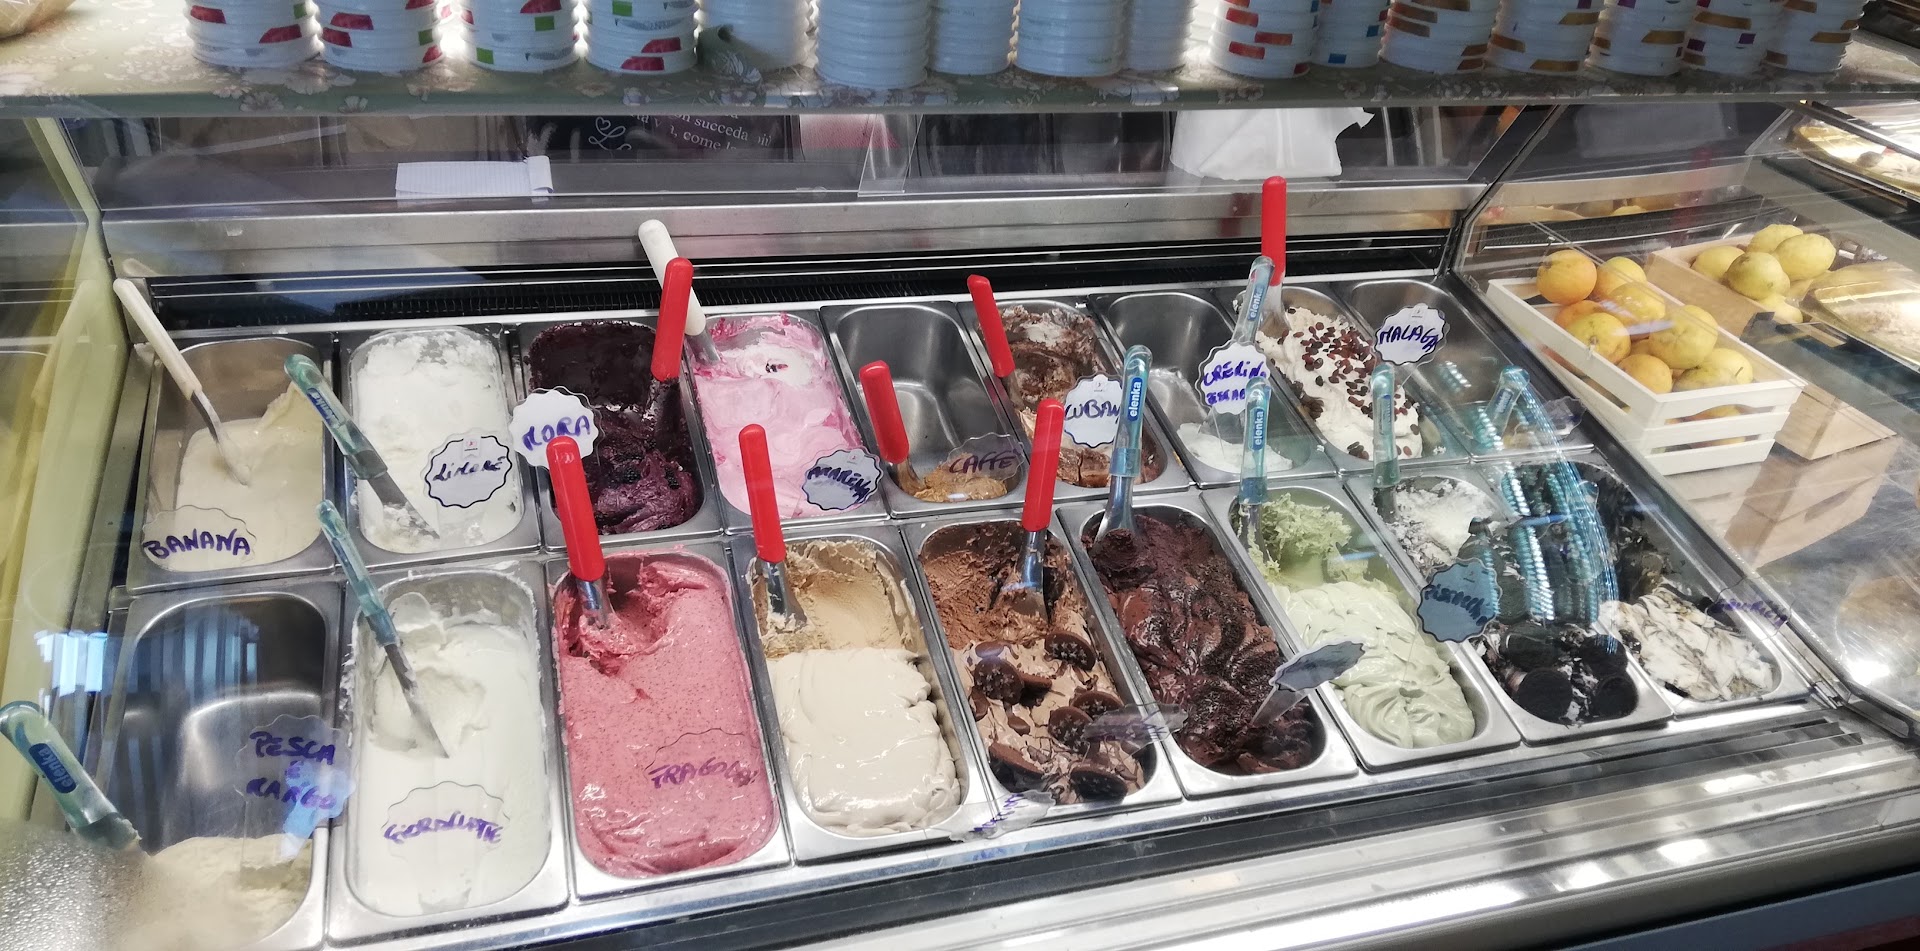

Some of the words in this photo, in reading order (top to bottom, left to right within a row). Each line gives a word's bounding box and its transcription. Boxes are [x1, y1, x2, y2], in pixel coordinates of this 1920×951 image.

[683, 131, 721, 149] come
[694, 118, 748, 141] succeda
[1250, 287, 1264, 319] elenka
[1379, 324, 1439, 352] MALAGA
[1128, 381, 1141, 416] elenka
[1254, 411, 1264, 446] elenka
[143, 528, 250, 559] BANANA
[249, 731, 336, 765] PESCA
[37, 746, 73, 788] elenka
